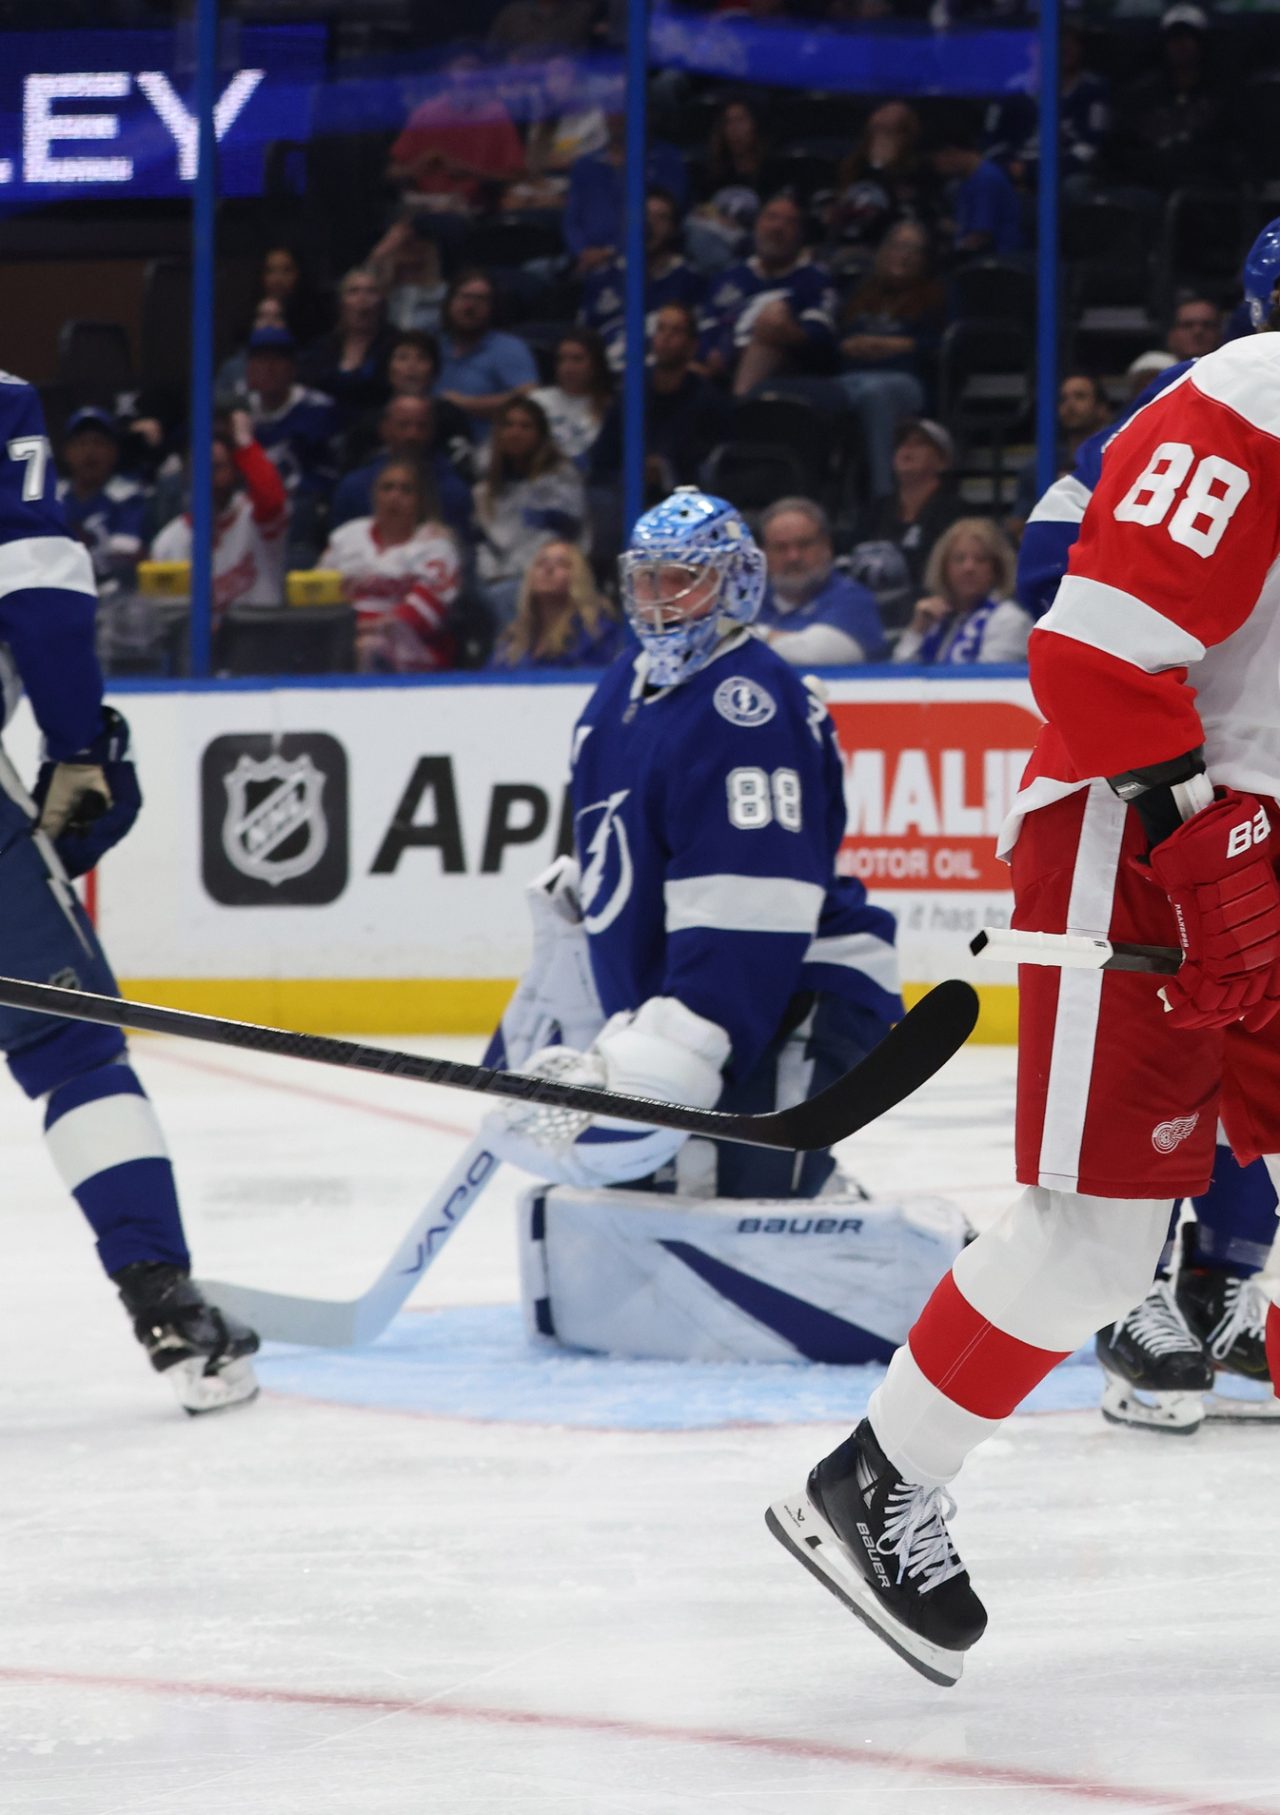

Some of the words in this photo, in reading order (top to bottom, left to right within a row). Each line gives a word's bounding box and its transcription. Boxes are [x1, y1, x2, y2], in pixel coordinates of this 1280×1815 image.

[0, 69, 265, 183] EY
[1113, 442, 1250, 559] 88
[368, 754, 575, 876] AP
[726, 766, 802, 833] 88
[934, 849, 981, 880] OIL
[737, 1218, 864, 1235] BAUER
[856, 1522, 891, 1588] BAUER
